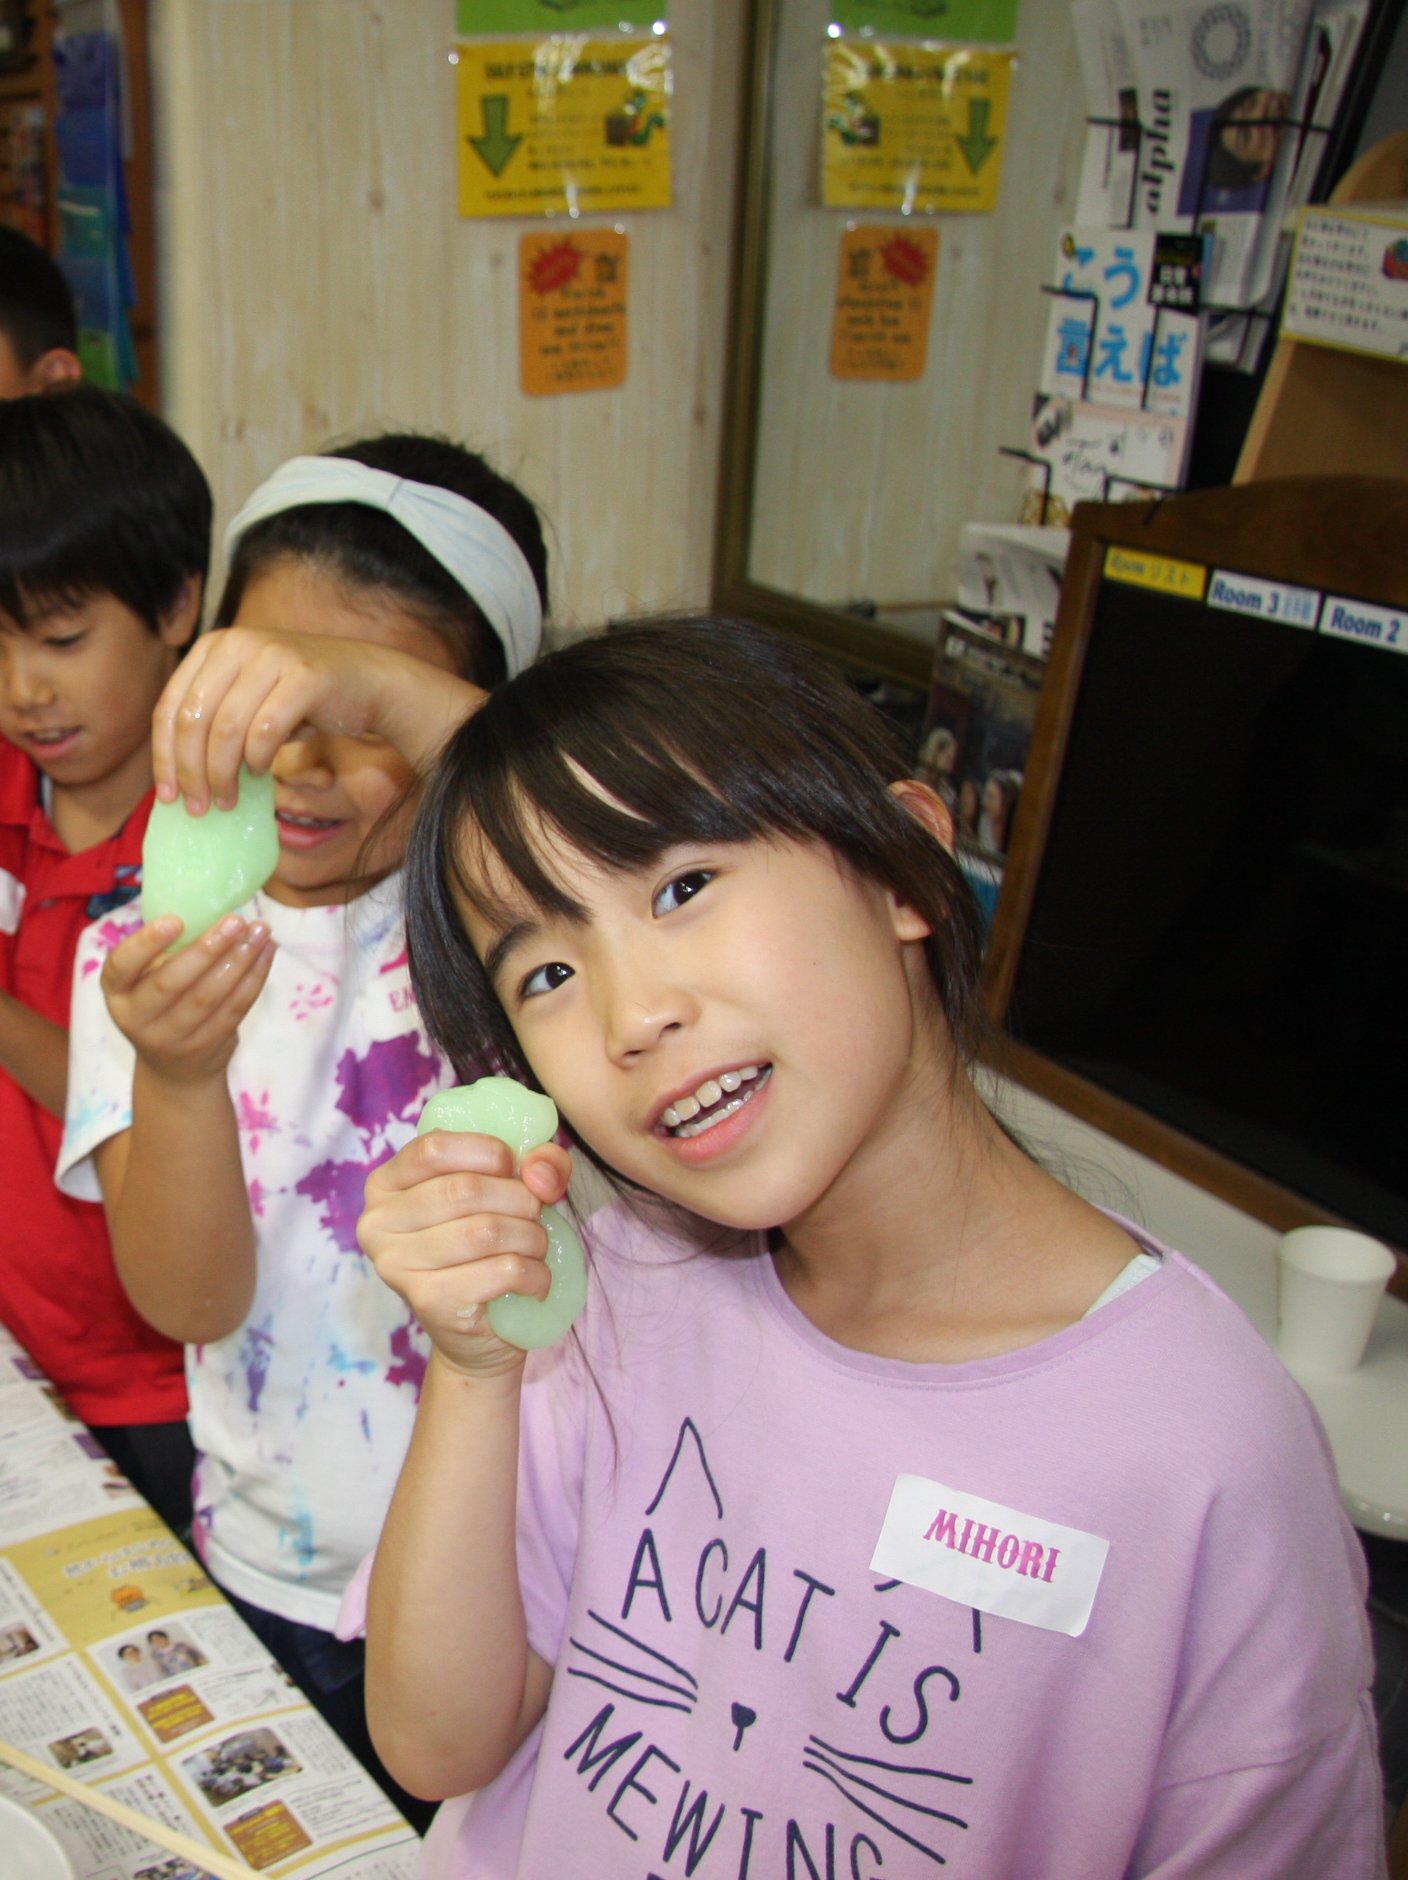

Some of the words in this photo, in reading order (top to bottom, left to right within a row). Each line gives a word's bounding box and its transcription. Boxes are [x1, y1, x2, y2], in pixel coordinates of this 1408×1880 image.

[1142, 88, 1175, 215] alpha
[1210, 578, 1263, 612] Room
[1267, 592, 1280, 616] 3
[1330, 606, 1383, 640] Room
[1387, 619, 1402, 645] 2
[922, 1507, 1063, 1584] MIHORI
[620, 1527, 673, 1622] A
[694, 1537, 836, 1664] CAT
[835, 1618, 962, 1746] IS
